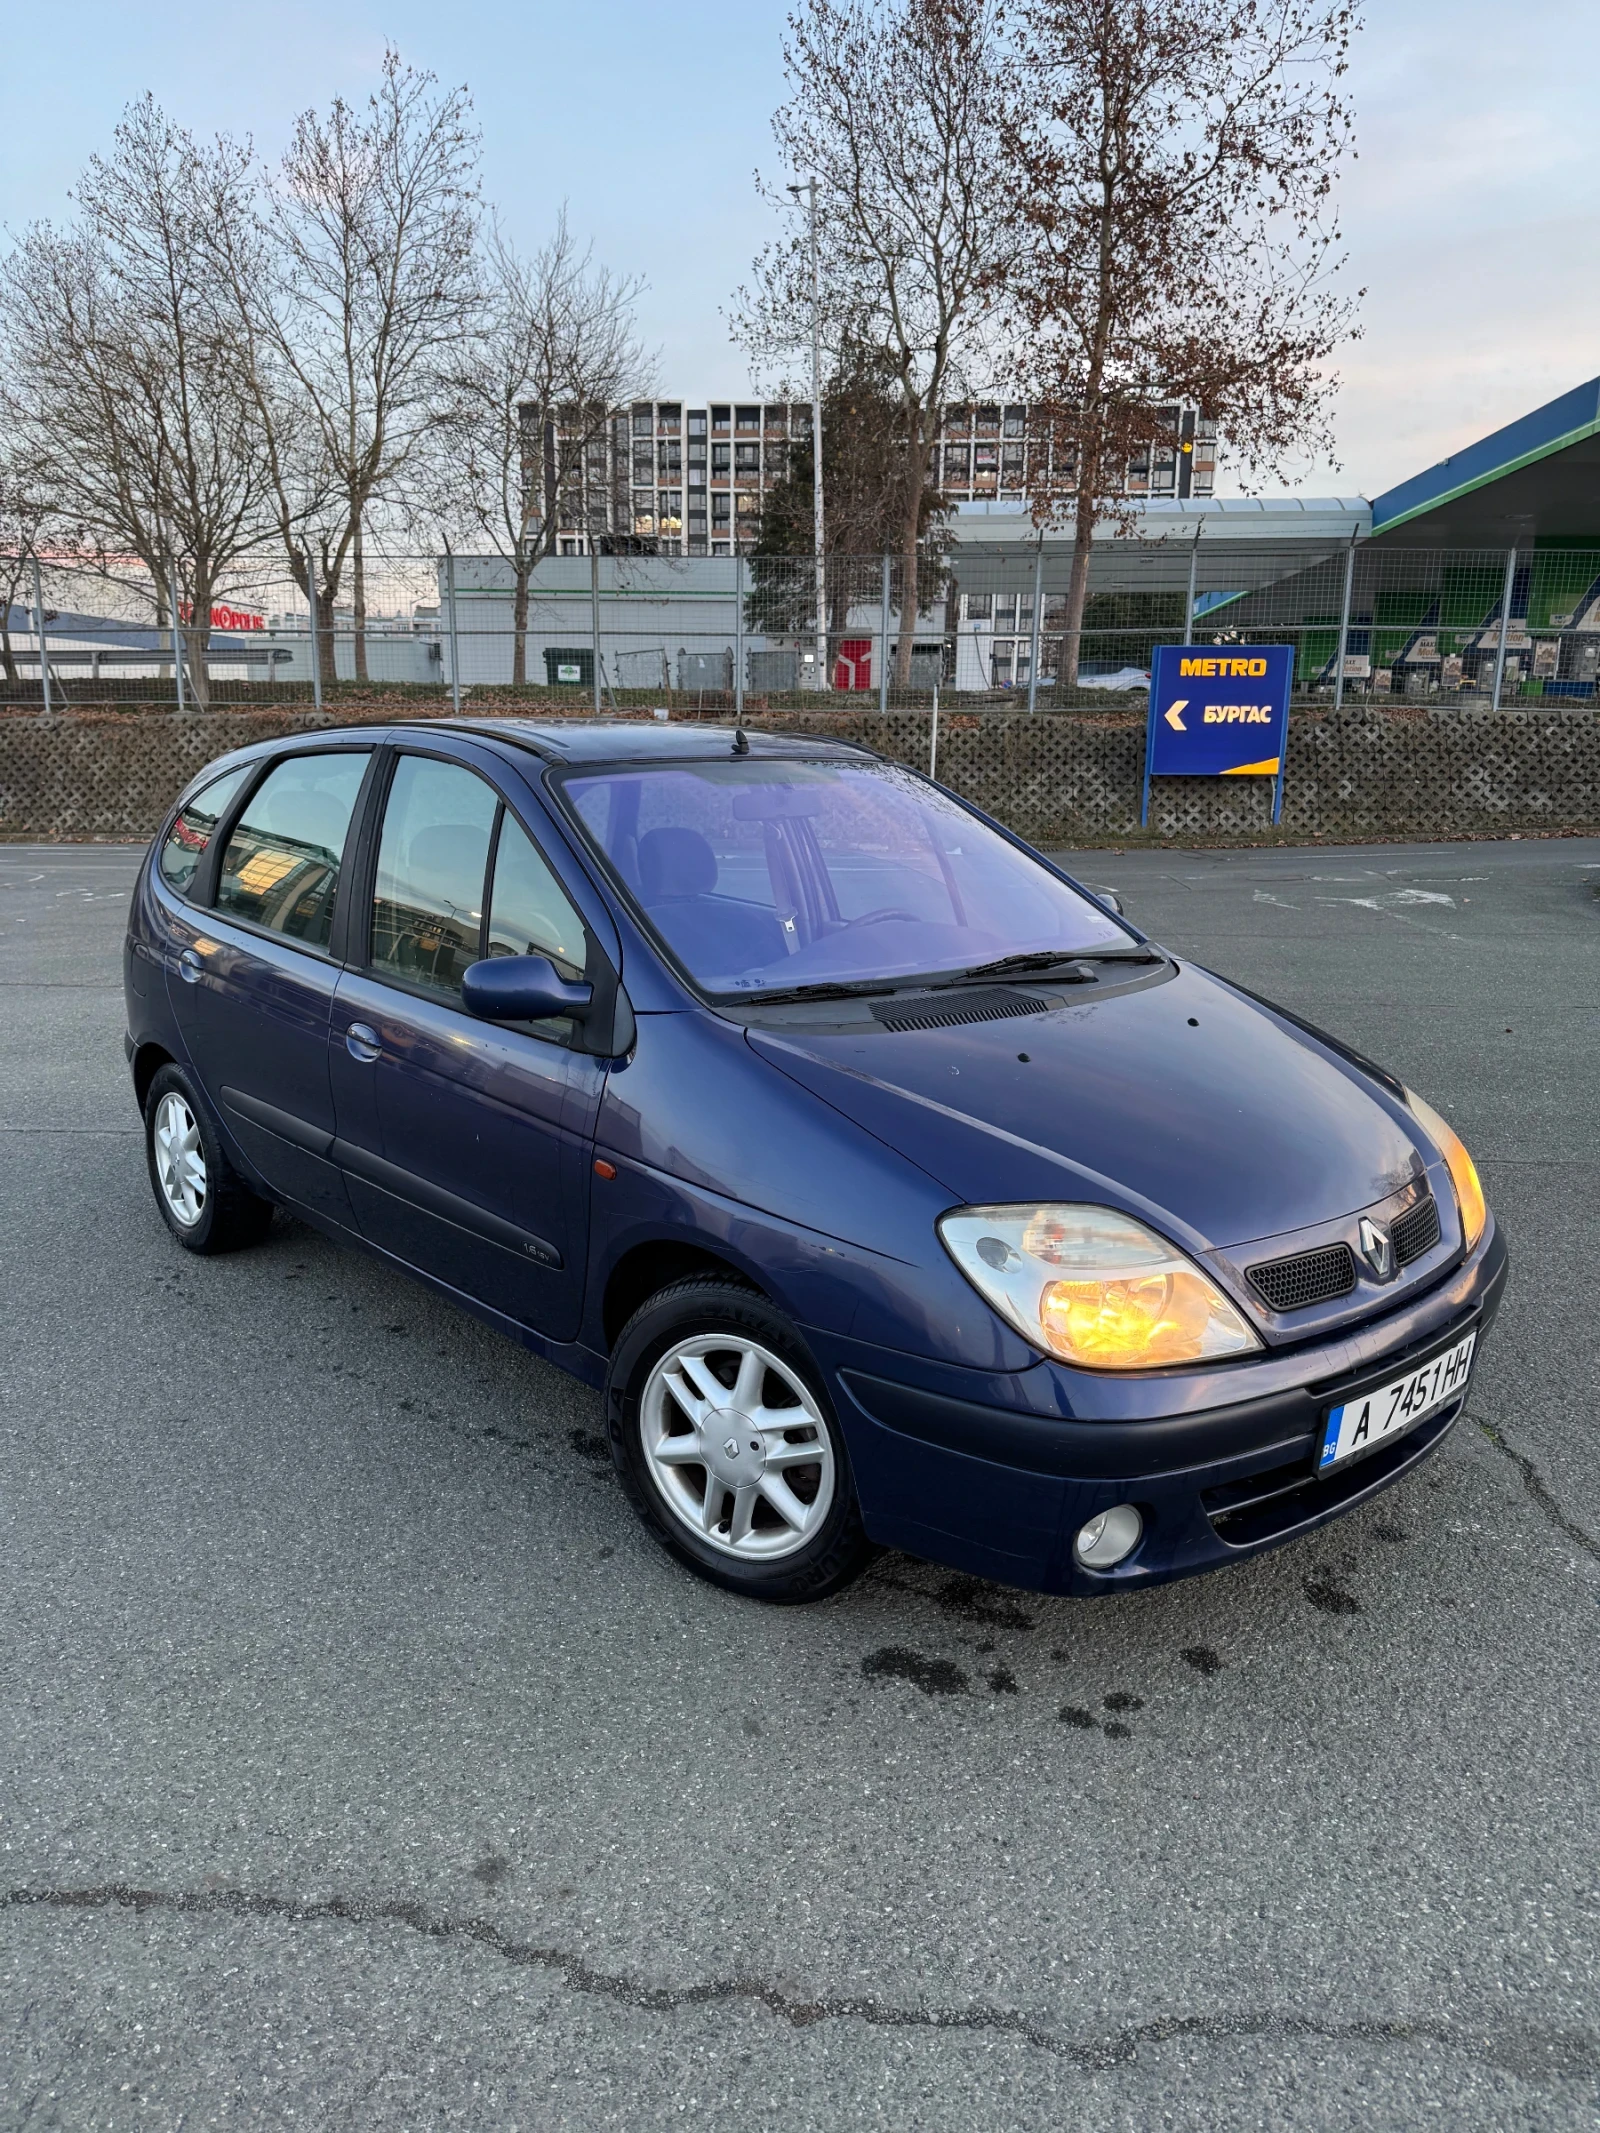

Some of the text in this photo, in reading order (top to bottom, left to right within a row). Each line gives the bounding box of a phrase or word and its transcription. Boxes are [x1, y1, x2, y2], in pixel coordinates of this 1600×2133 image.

[1180, 658, 1267, 676] METRO
[1203, 705, 1272, 723] БУРГАС
[1351, 1401, 1371, 1446] A
[1383, 1361, 1442, 1430] 7451
[1441, 1340, 1472, 1394] HH
[1322, 1441, 1337, 1458] BG
